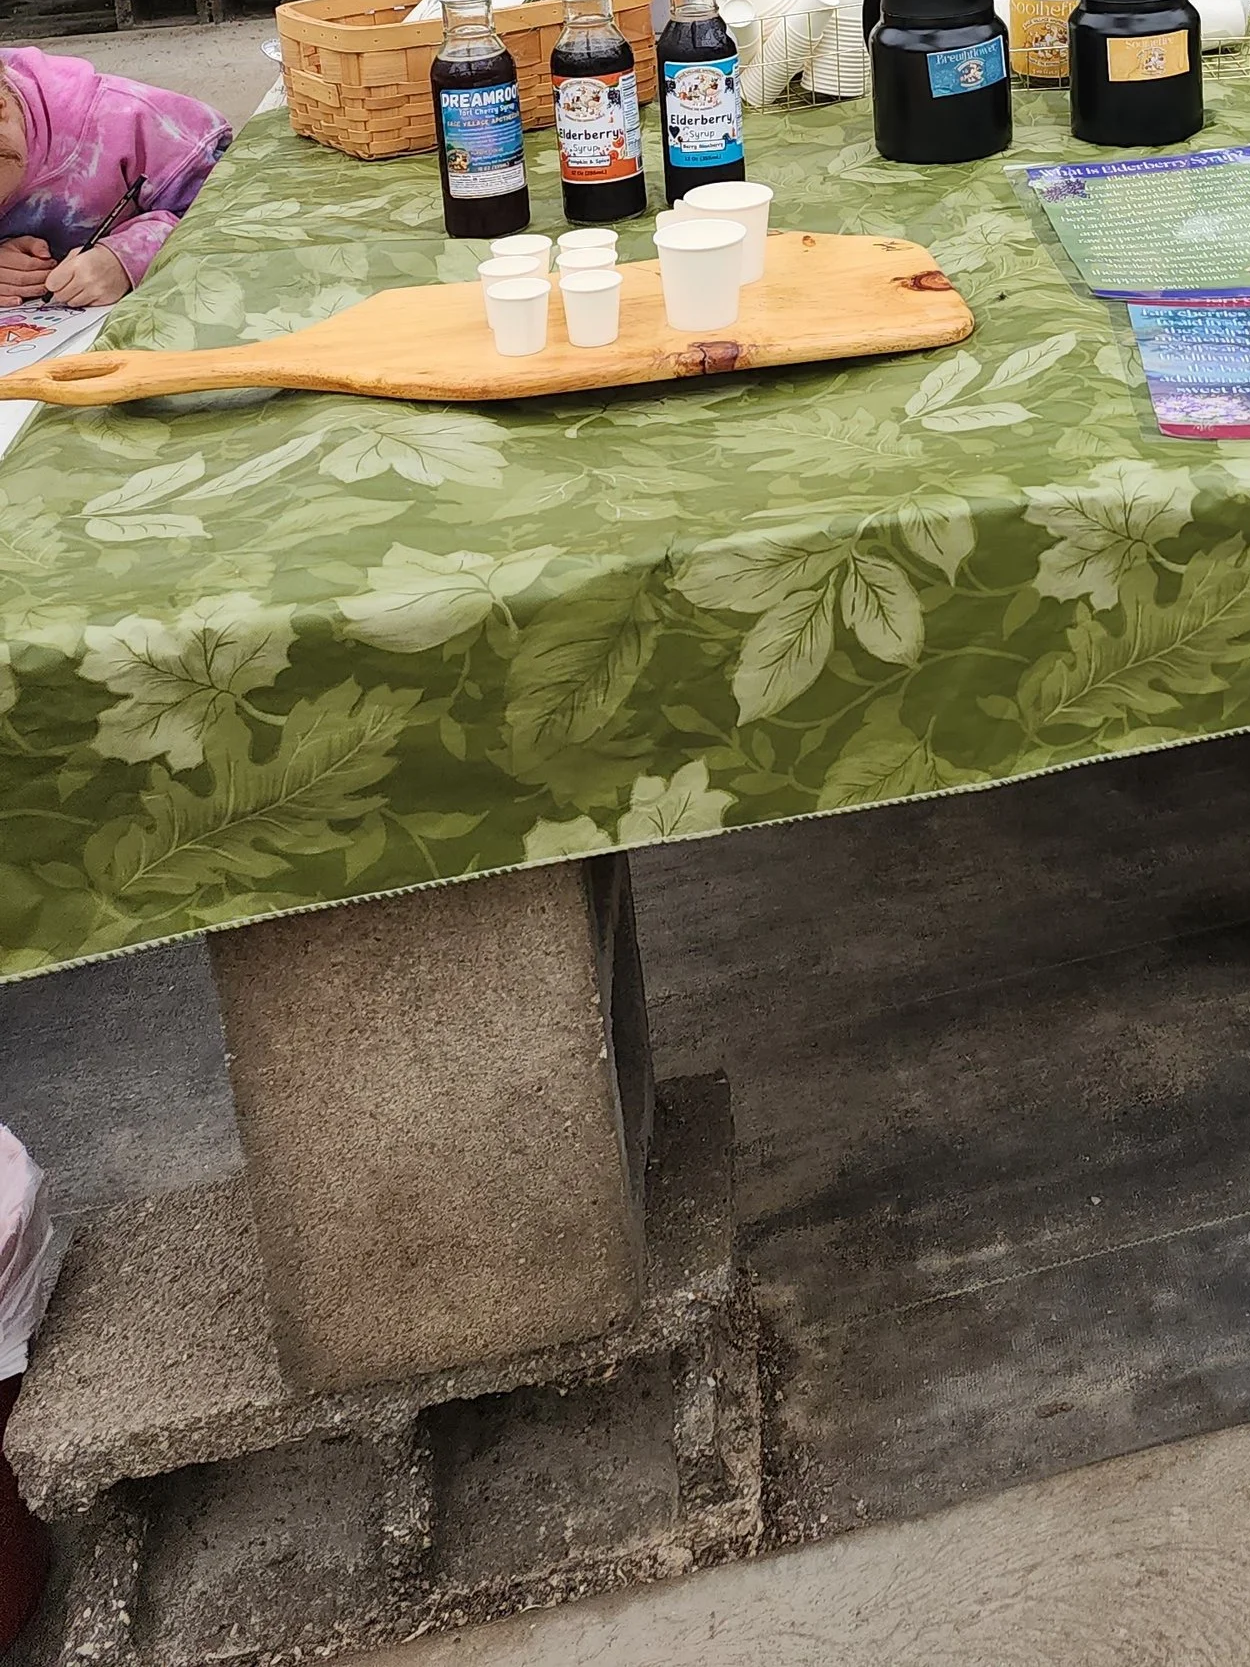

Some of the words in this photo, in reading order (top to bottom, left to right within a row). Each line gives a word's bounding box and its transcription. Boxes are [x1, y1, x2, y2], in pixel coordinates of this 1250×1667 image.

[670, 114, 733, 126] Elderberry
[559, 128, 620, 141] Elderberry
[689, 130, 716, 139] Syrup
[573, 143, 600, 154] Syrup
[1101, 159, 1188, 174] Elderberry
